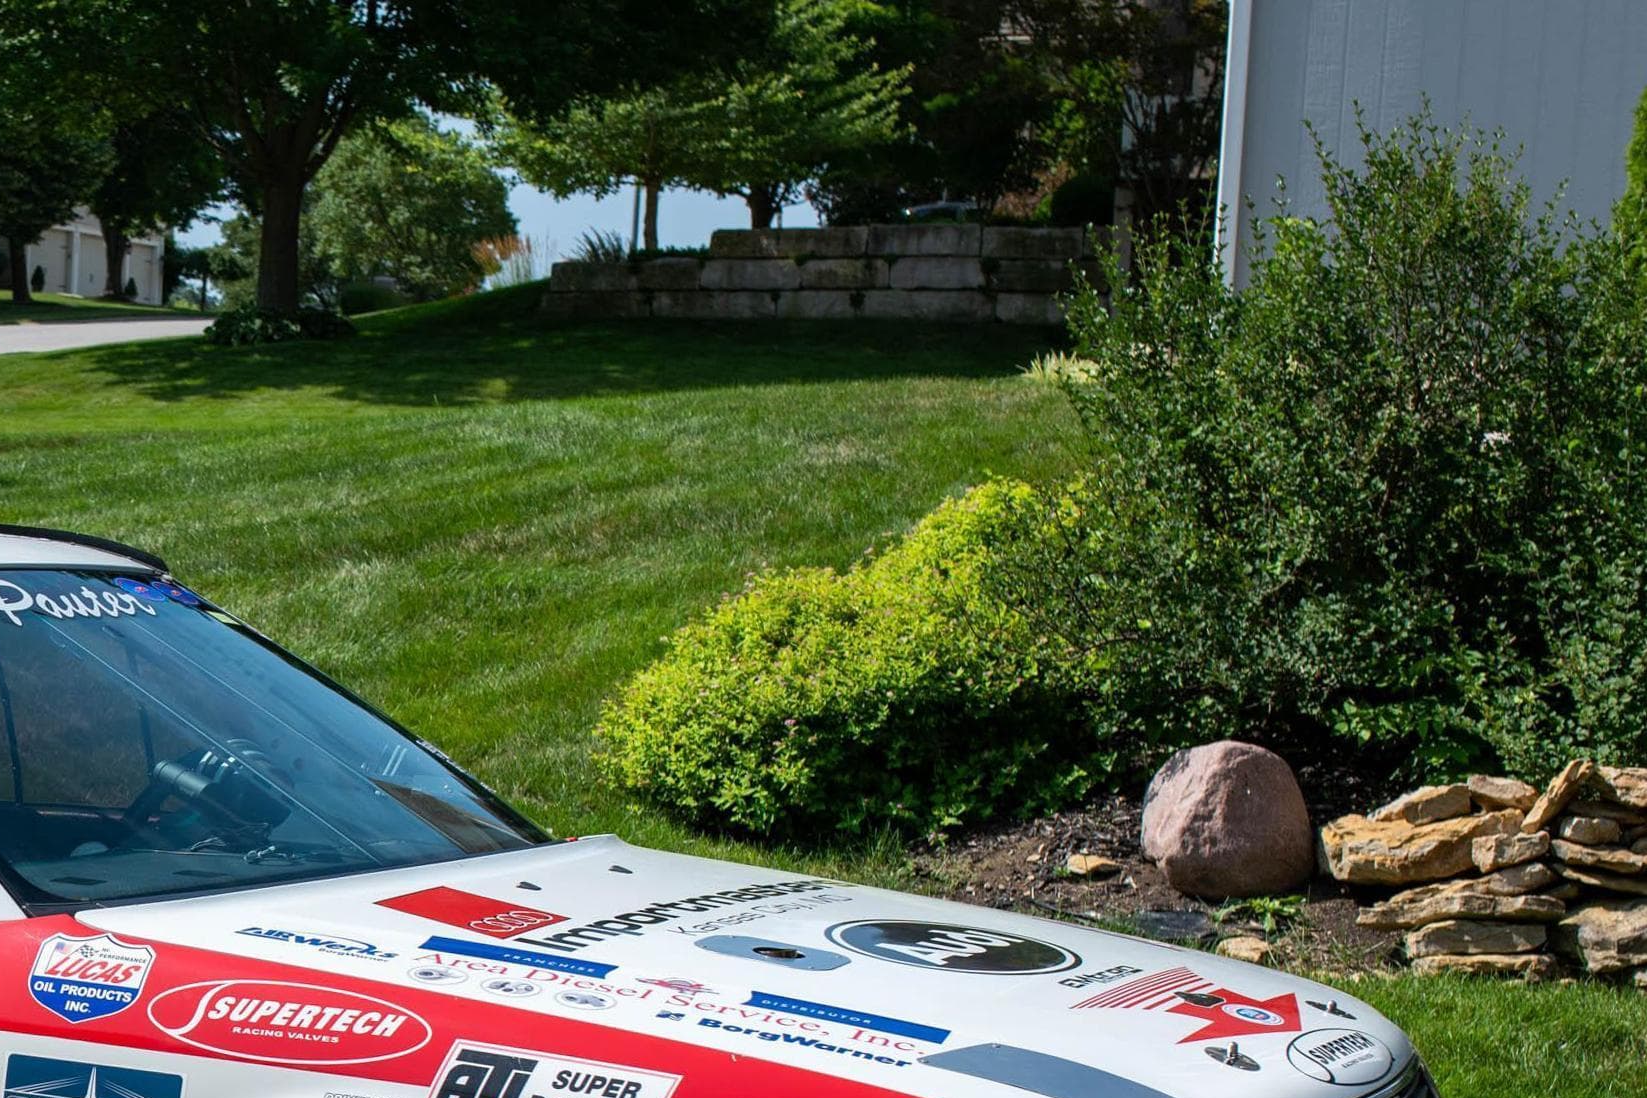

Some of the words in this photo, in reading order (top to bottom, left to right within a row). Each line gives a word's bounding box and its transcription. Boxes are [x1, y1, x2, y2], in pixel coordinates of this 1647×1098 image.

[668, 911, 765, 937] Kansas
[99, 953, 147, 964] PERFORMANCE
[876, 929, 1025, 966] Audi
[44, 957, 142, 983] LUCAS
[503, 953, 595, 973] FRANCHISE
[33, 981, 55, 993] OIL
[60, 984, 132, 1003] PRODUCTS
[413, 953, 507, 976] Area
[523, 969, 652, 999] Diesel
[665, 994, 831, 1036] Service,
[849, 1029, 925, 1055] Inc.
[64, 1000, 91, 1013] INC.
[207, 995, 409, 1038] SUPERTECH
[761, 999, 872, 1025] DISTRIBUTOR
[232, 1026, 284, 1040] RACING
[287, 1031, 340, 1044] VALVES
[697, 1017, 912, 1068] BorgWarner
[1308, 1031, 1375, 1065] SUPERTECH
